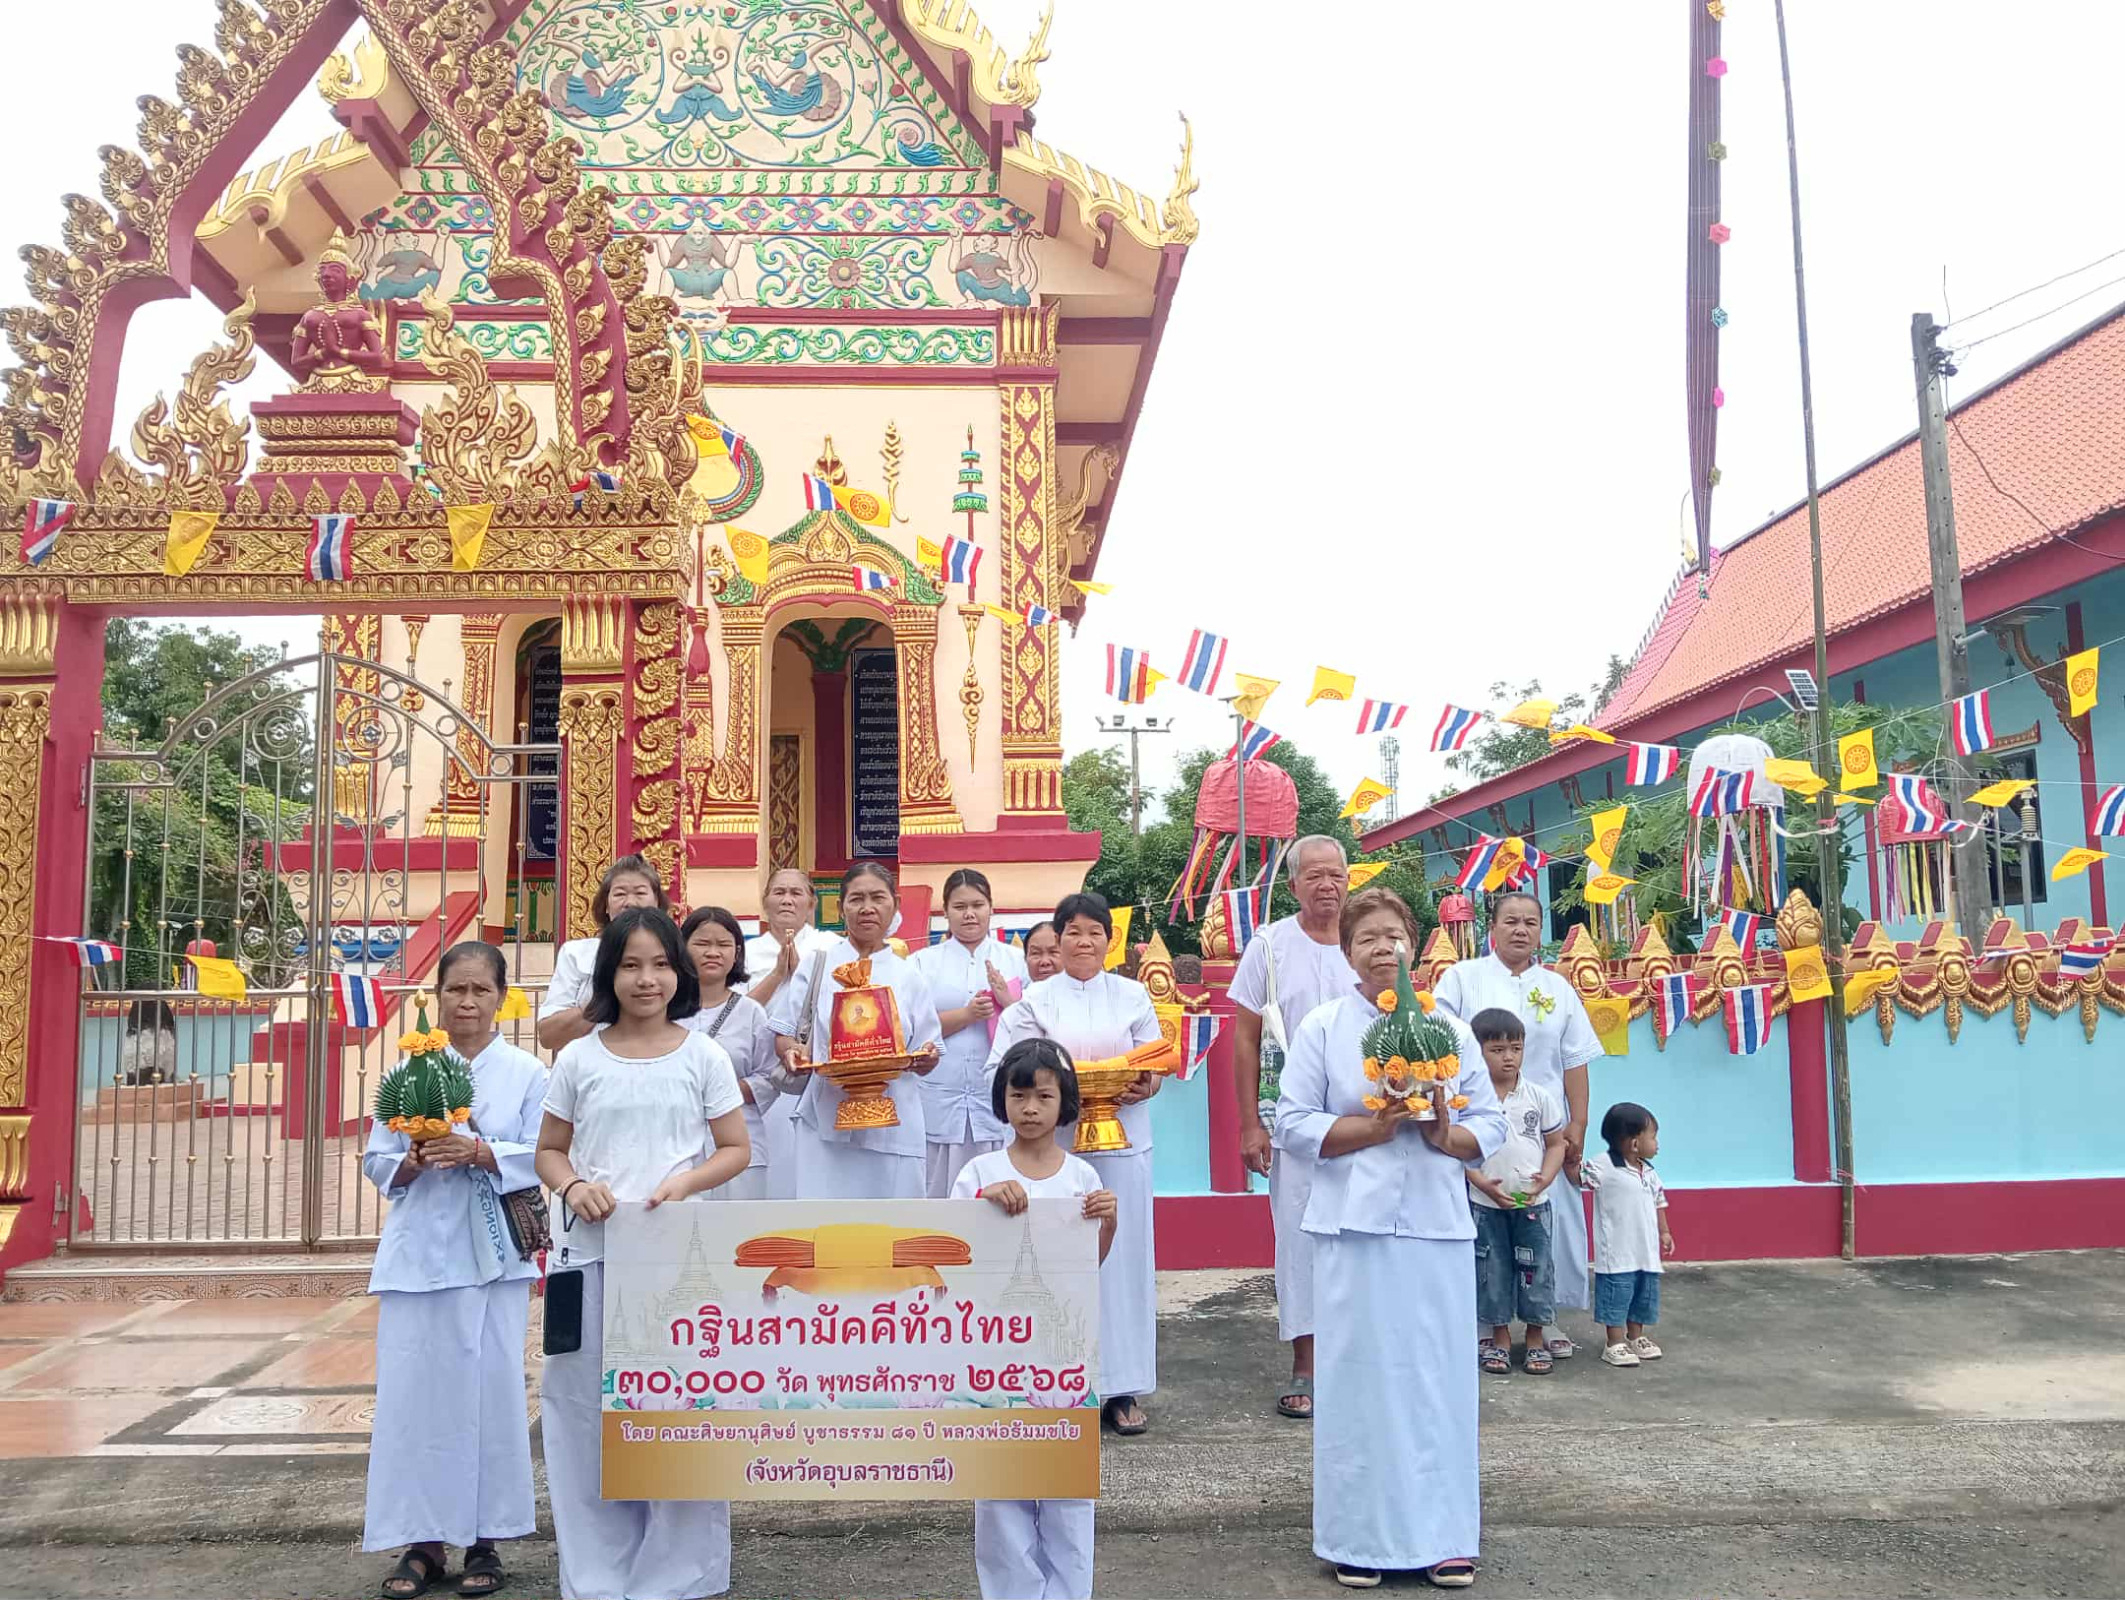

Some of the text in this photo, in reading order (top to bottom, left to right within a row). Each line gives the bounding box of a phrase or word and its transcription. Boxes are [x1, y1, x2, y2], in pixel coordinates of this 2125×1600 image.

[670, 1290, 1033, 1358] กฐินสามัคคีทั่วไทย
[618, 1363, 1086, 1402] ๓๐,๐๐๐ วัด พุทธศักราช ๒๕๖๘
[622, 1421, 654, 1440] โดย
[661, 1421, 797, 1444] คณะศิษยานุศิษย์
[803, 1425, 885, 1445] บูชาธรรม
[923, 1421, 935, 1439] ปี
[746, 1457, 954, 1488] (จังหวัดอุบลราชธานี)
